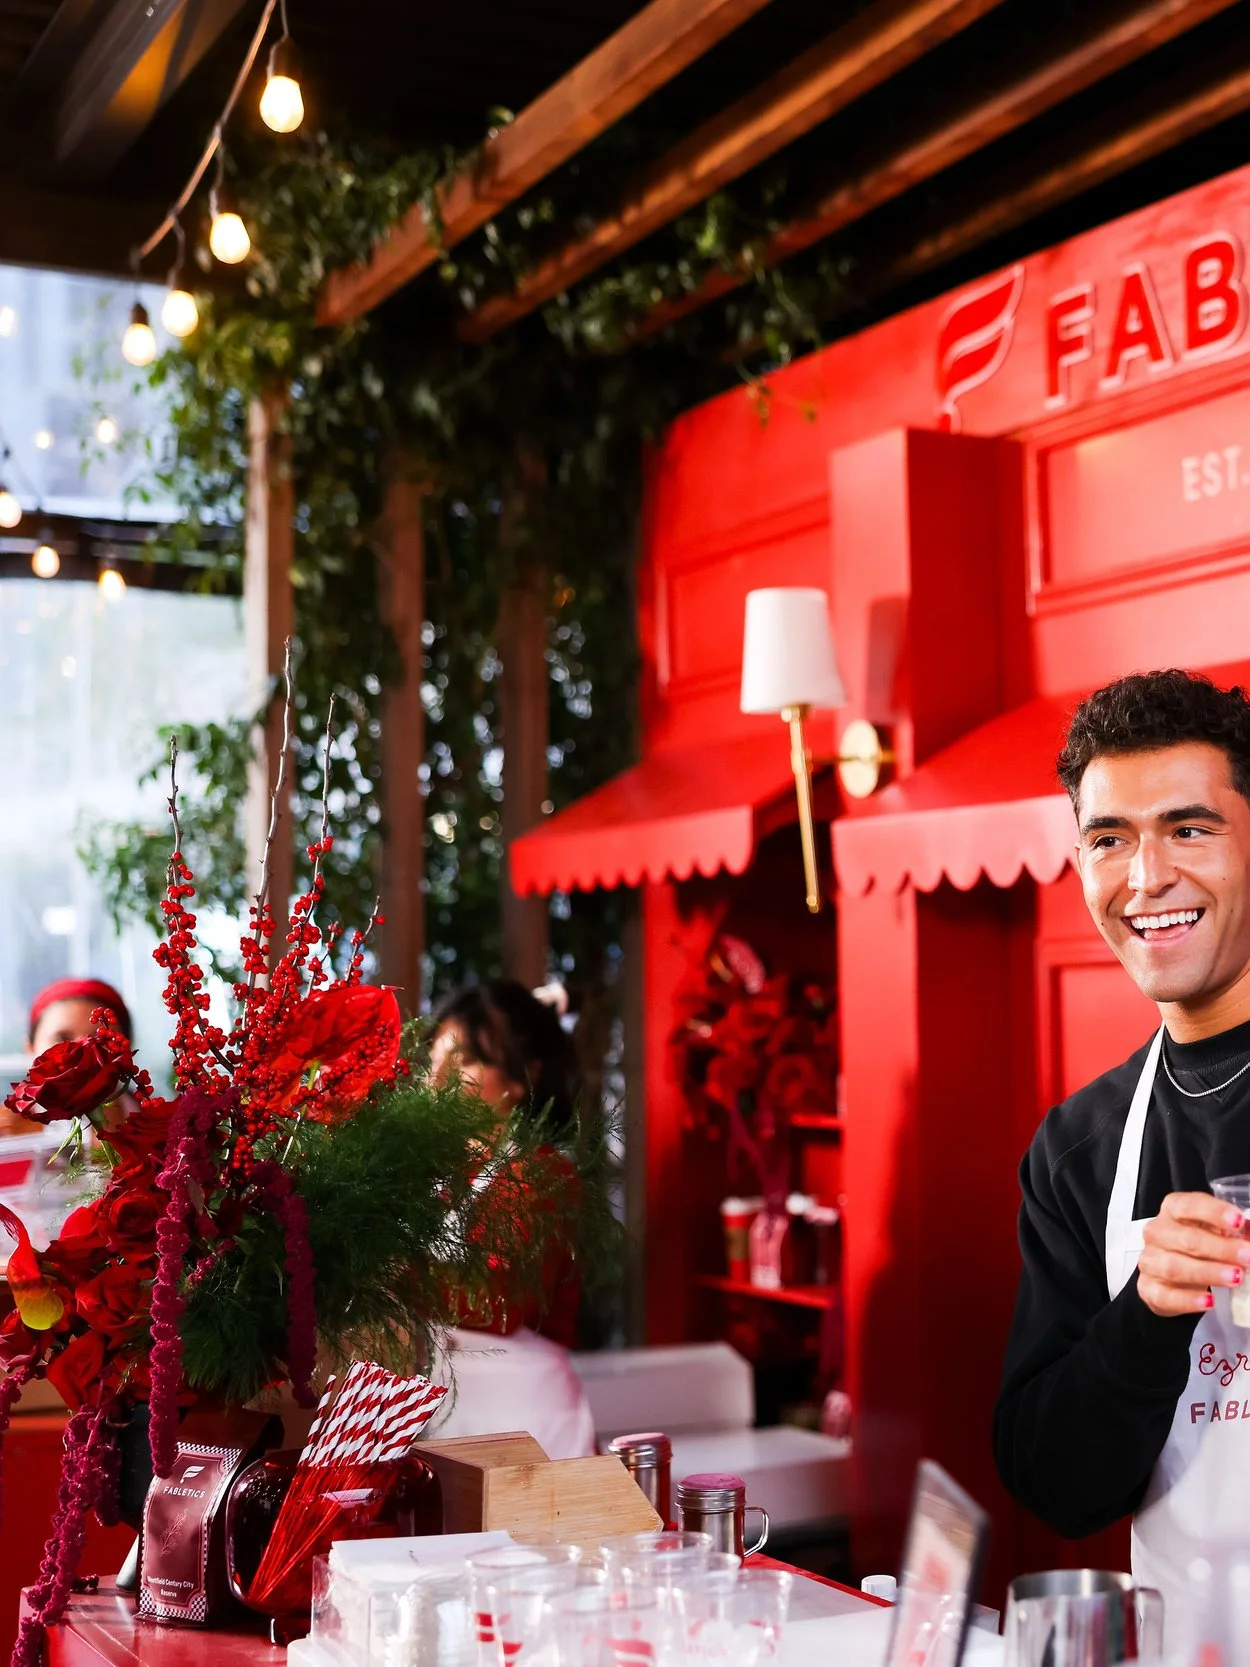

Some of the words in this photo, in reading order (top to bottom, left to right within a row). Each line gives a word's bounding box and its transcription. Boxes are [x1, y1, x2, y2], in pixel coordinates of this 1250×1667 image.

[162, 1486, 206, 1498] FABLETICS
[165, 1578, 182, 1588] Century
[183, 1580, 195, 1589] City
